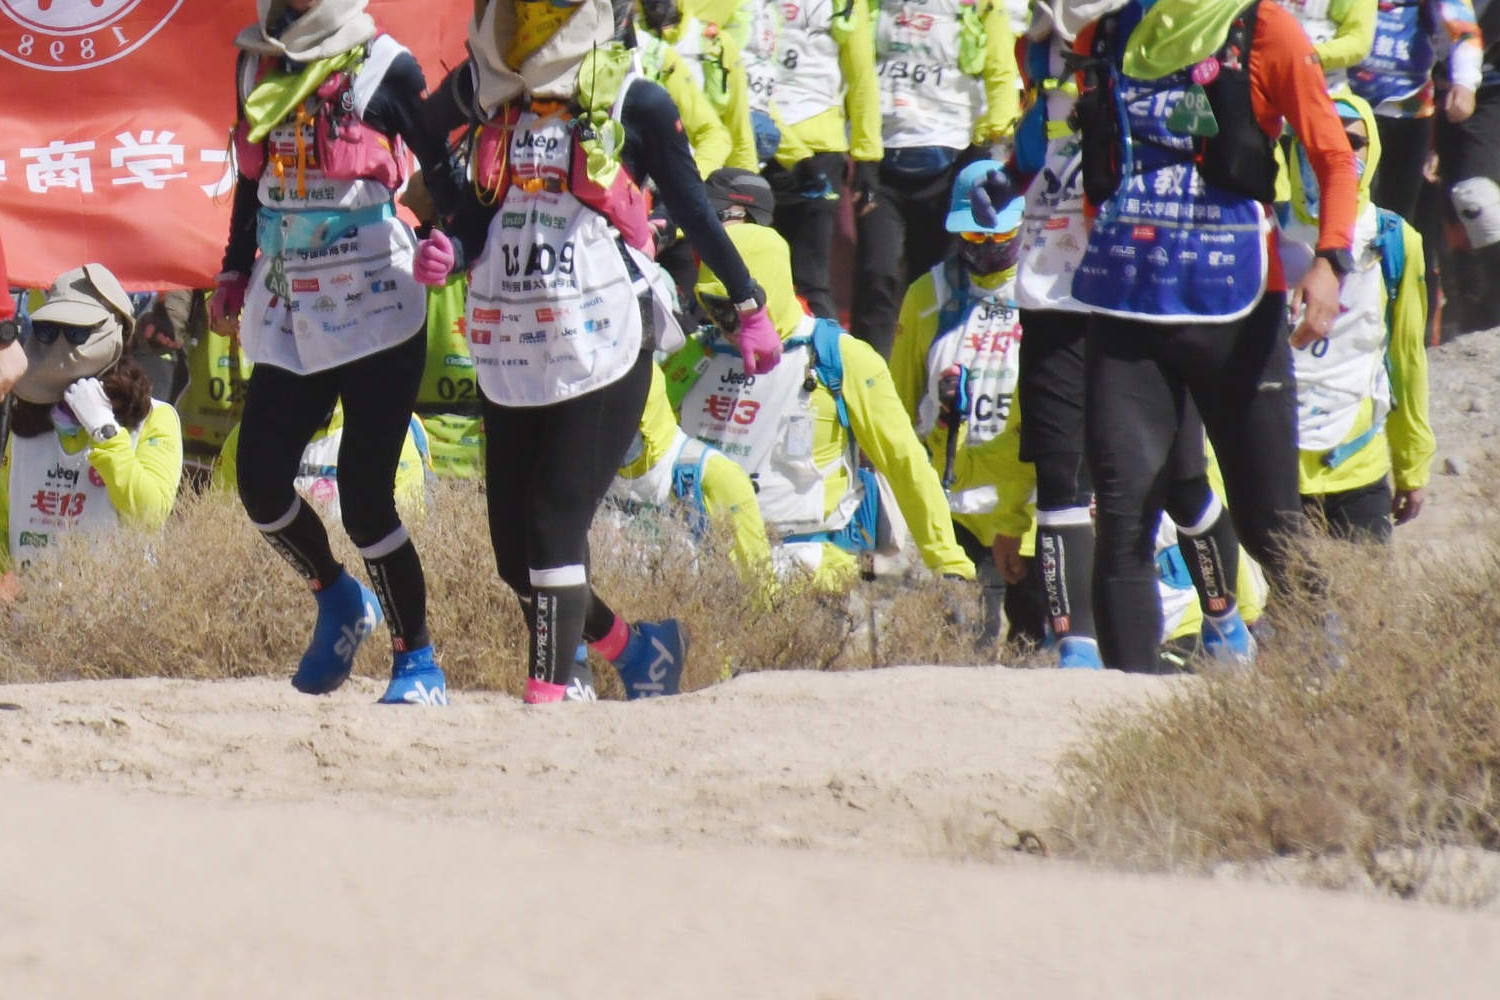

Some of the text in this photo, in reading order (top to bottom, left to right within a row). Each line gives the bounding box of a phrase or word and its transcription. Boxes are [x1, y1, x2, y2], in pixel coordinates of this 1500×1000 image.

[1185, 92, 1206, 110] 08
[515, 129, 559, 153] Jeep
[720, 367, 757, 390] Jeep
